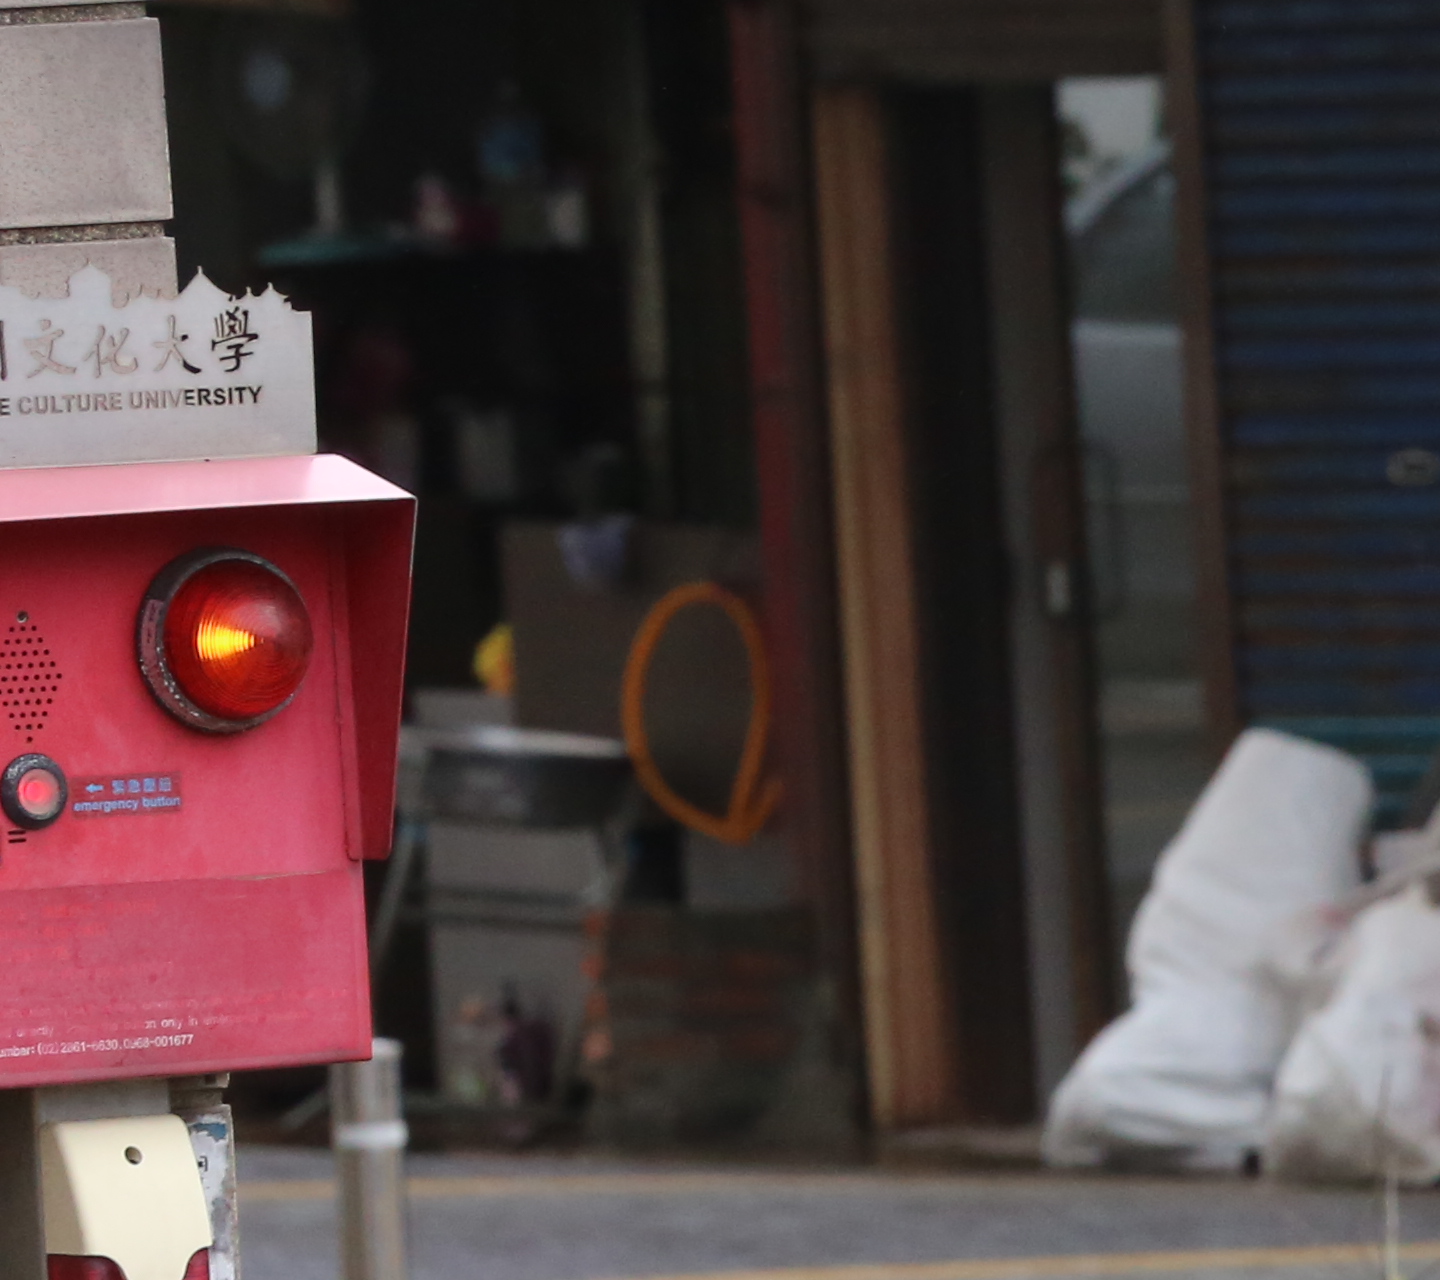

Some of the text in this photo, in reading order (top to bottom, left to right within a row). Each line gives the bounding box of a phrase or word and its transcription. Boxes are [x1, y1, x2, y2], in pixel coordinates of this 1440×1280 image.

[0, 306, 259, 380] 文化大學
[18, 392, 122, 414] CULTURE
[129, 386, 263, 409] UNIVERSITY
[73, 796, 181, 813] emergency button
